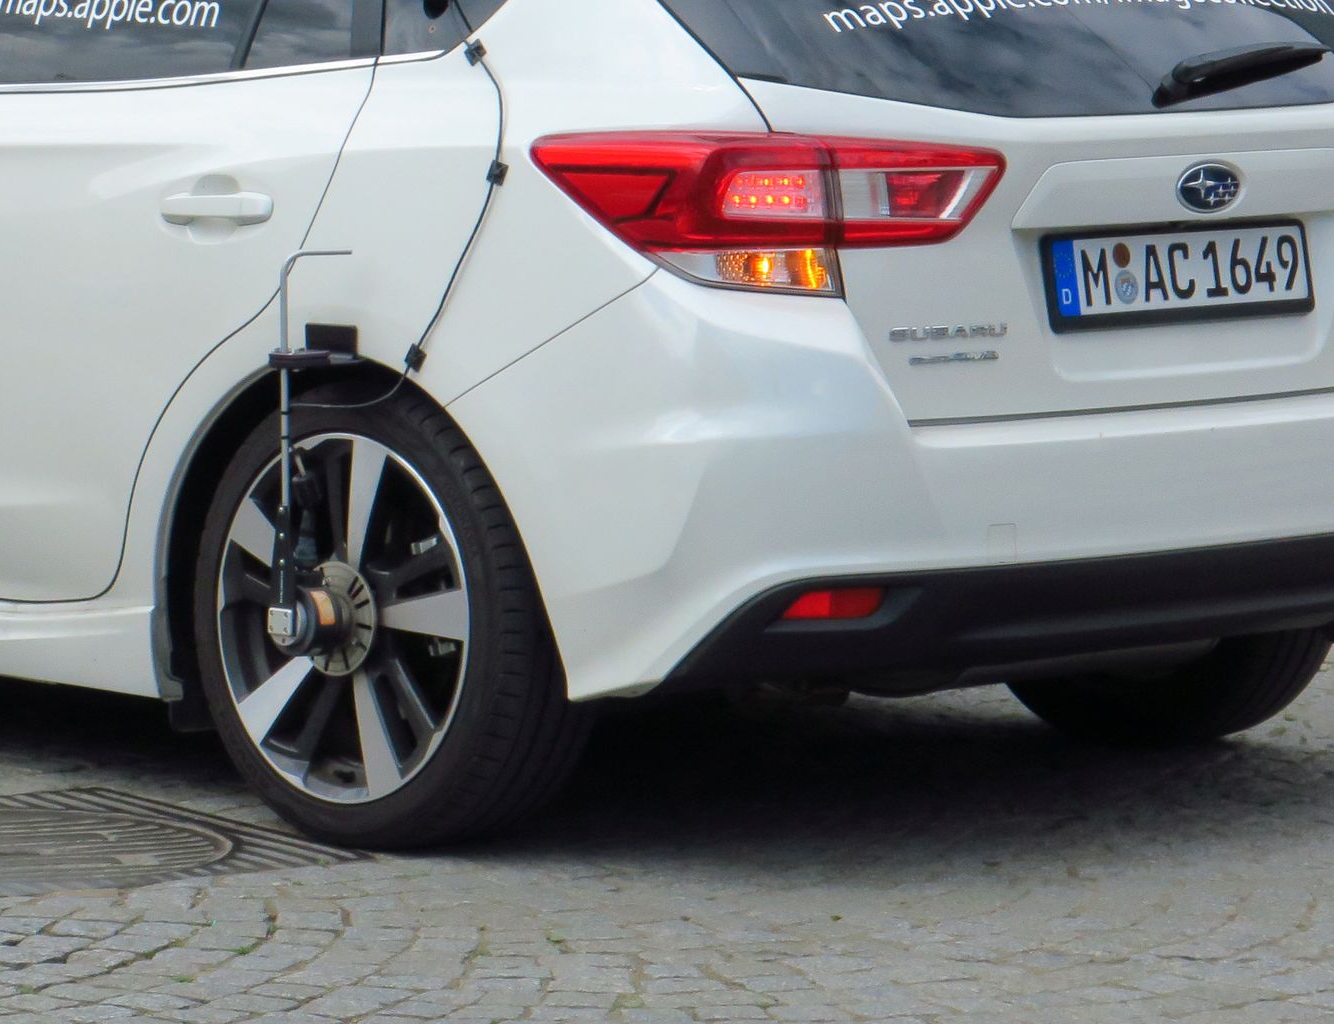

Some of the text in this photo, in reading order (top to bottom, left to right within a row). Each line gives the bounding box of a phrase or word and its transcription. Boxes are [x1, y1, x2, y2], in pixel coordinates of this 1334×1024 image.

[1080, 247, 1113, 307] M
[1202, 234, 1299, 297] 1649
[1062, 288, 1072, 305] D
